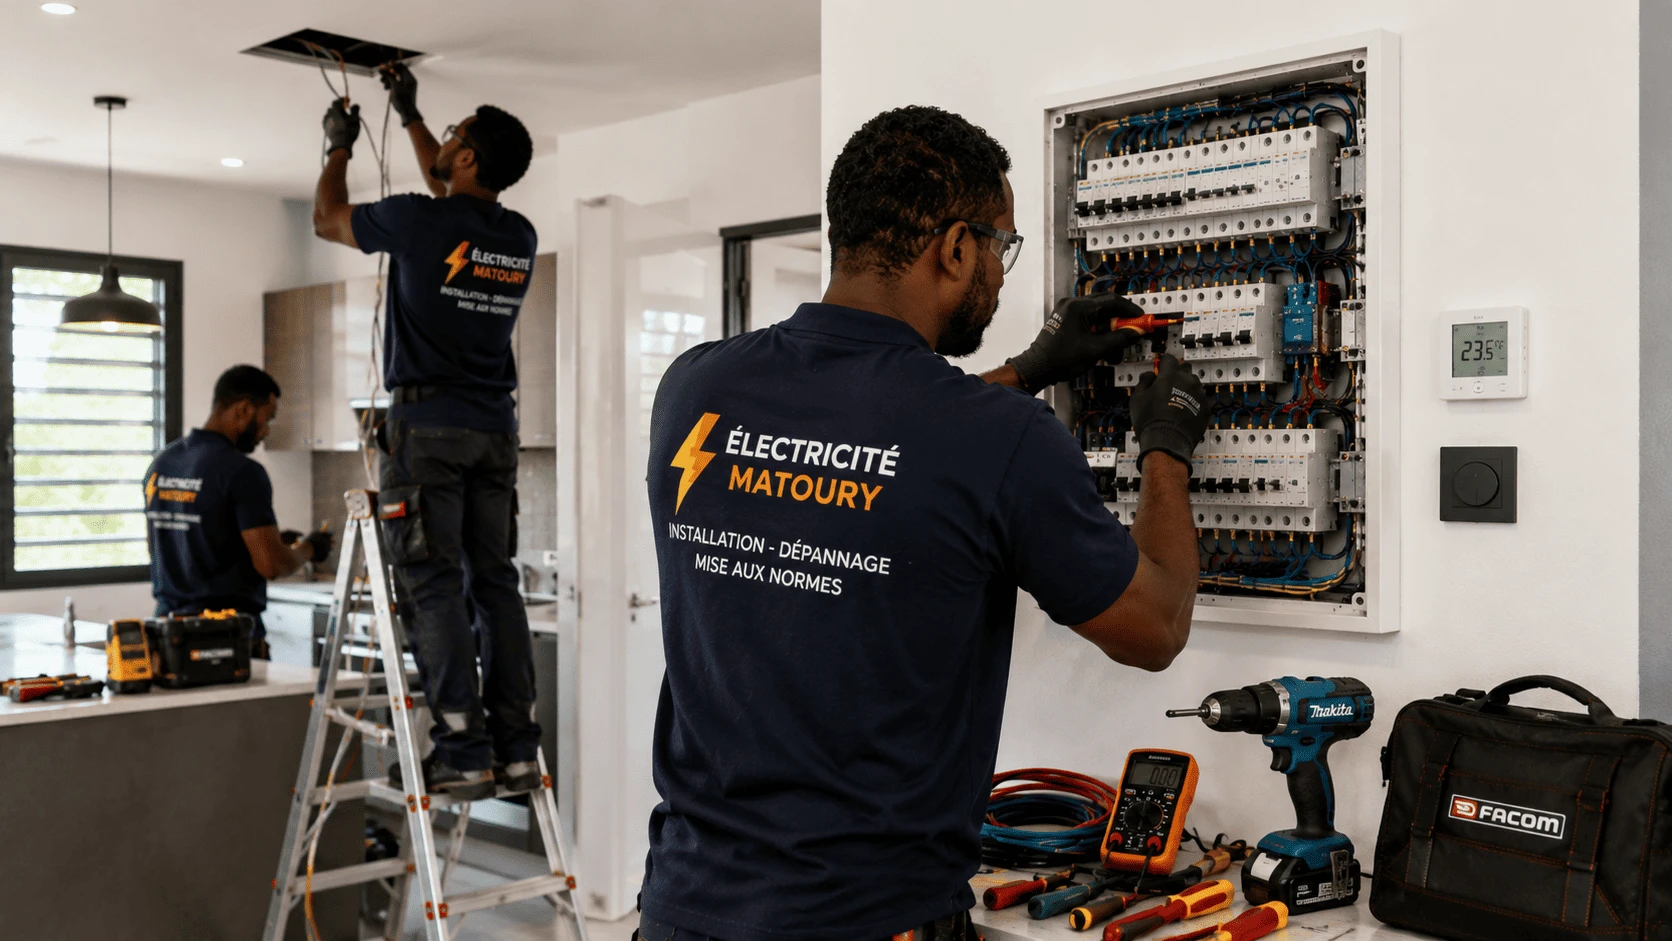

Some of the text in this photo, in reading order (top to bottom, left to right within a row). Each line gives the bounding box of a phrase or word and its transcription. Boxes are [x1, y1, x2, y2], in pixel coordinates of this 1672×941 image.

[471, 247, 530, 270] ÉLECTRICITÉ
[473, 265, 527, 284] MATOURY
[725, 425, 900, 477] ÉLECTRICITÉ
[728, 465, 883, 511] MATOURY
[668, 522, 765, 554] INSTALLATION
[779, 539, 891, 575] DÉPANNAGE
[695, 553, 843, 596] MISE AUX NORMES
[1309, 703, 1354, 718] Makita
